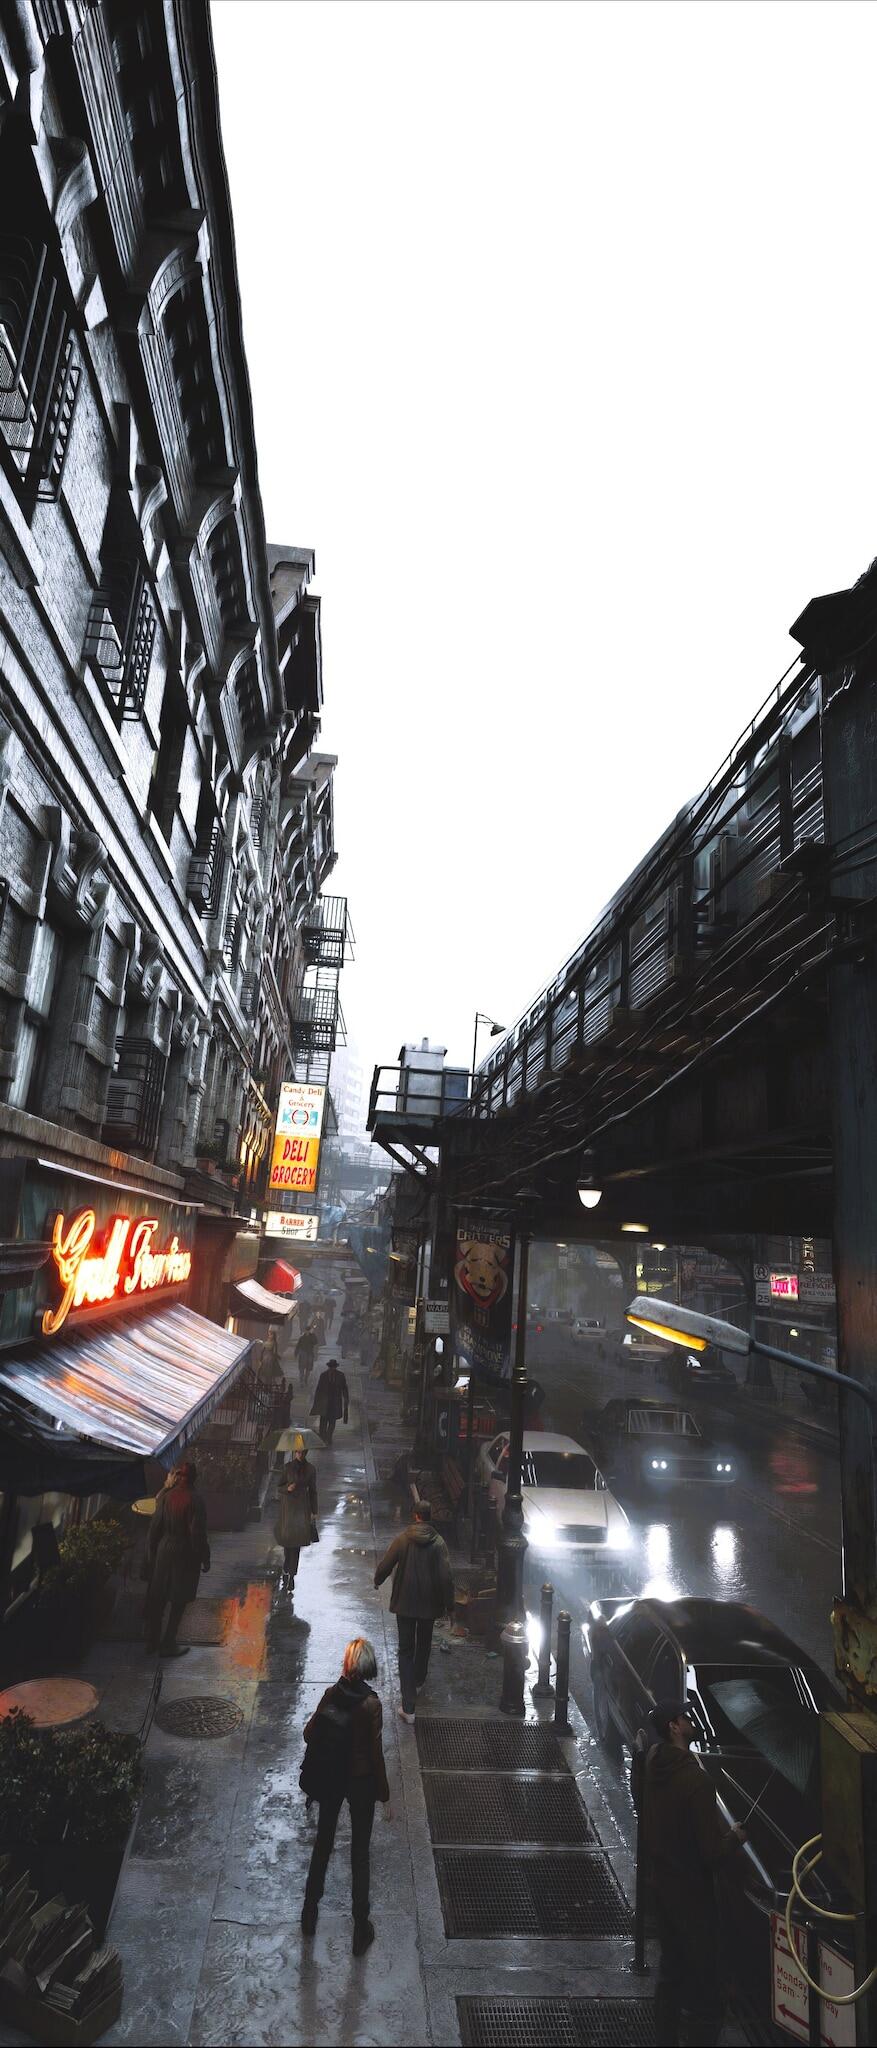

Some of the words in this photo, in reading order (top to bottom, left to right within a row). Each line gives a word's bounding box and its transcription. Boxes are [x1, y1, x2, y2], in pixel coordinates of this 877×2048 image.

[307, 1087, 323, 1096] Deli
[283, 1138, 310, 1163] DELI
[271, 1165, 315, 1186] GROCERY
[456, 1228, 511, 1249] CRITTERS
[757, 1294, 770, 1304] 25
[776, 1964, 808, 1994] Monday
[776, 1978, 795, 1998] 5am
